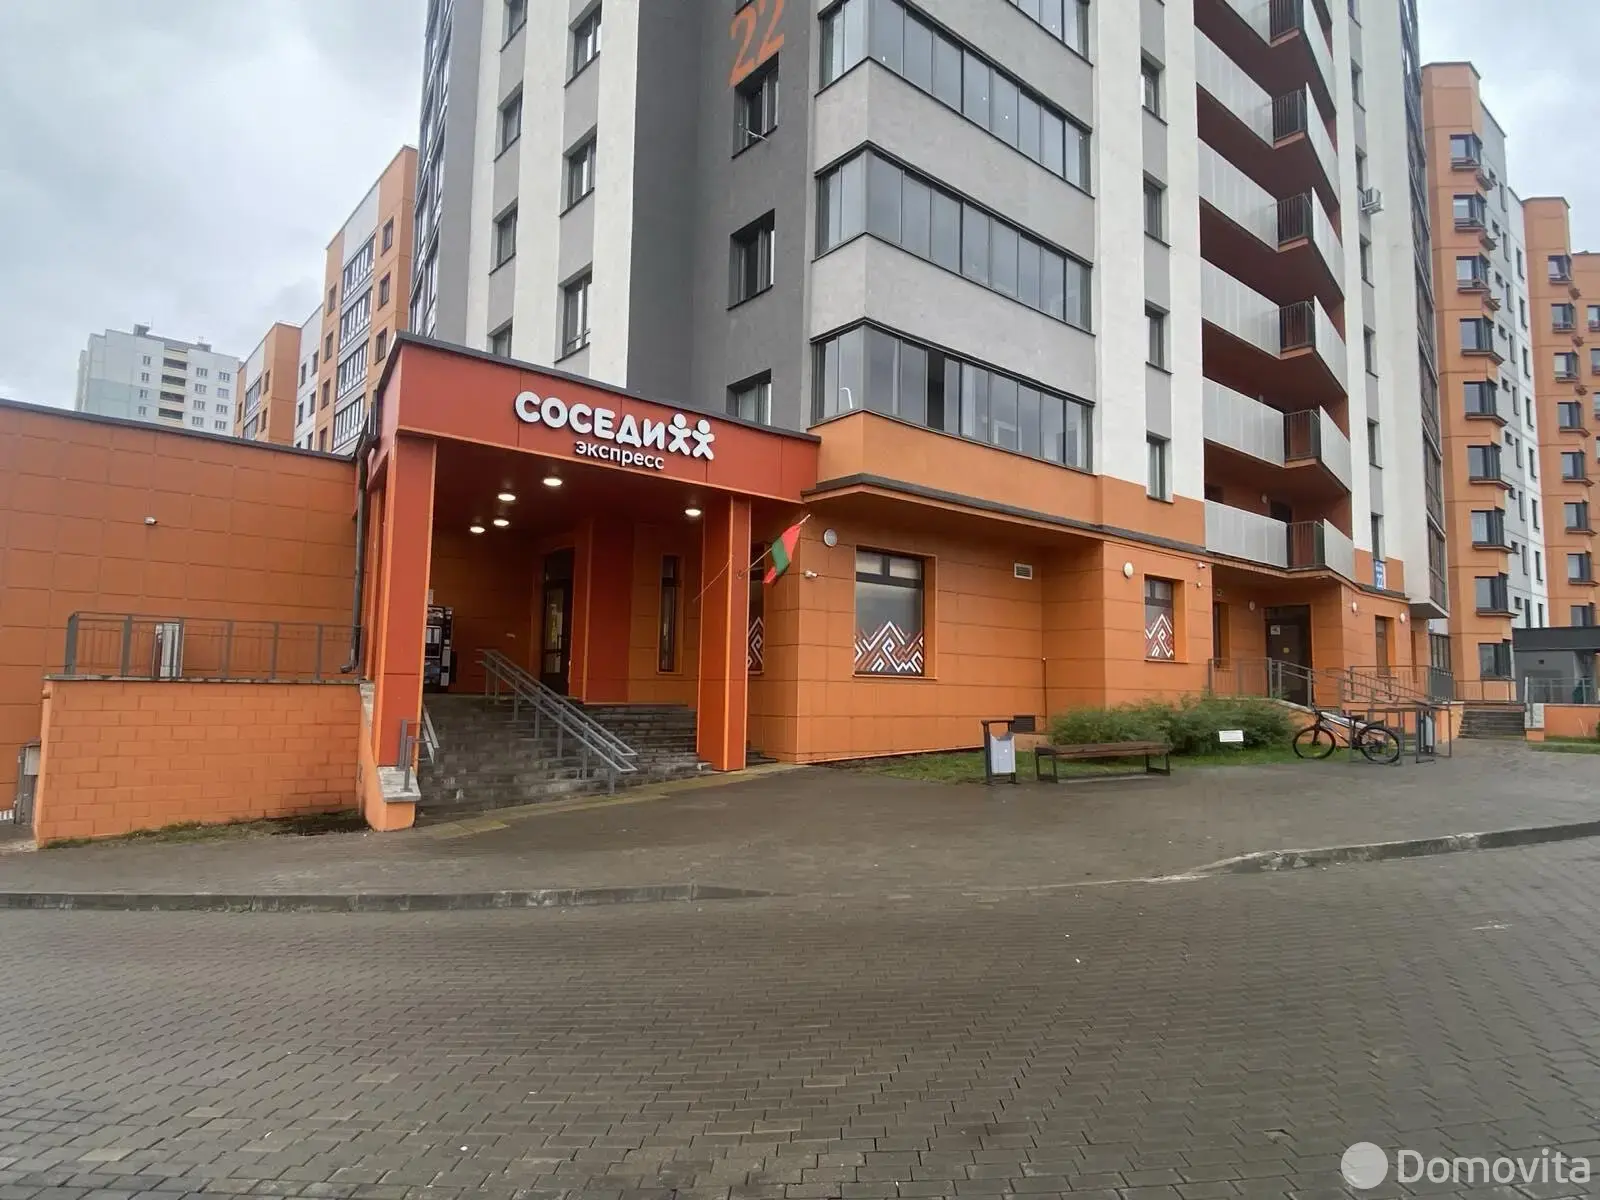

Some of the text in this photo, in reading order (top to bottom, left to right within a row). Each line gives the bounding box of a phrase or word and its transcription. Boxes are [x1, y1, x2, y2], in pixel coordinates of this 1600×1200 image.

[729, 0, 785, 88] 22
[514, 391, 665, 450] СОСЕДИ
[575, 440, 665, 470] экспресс
